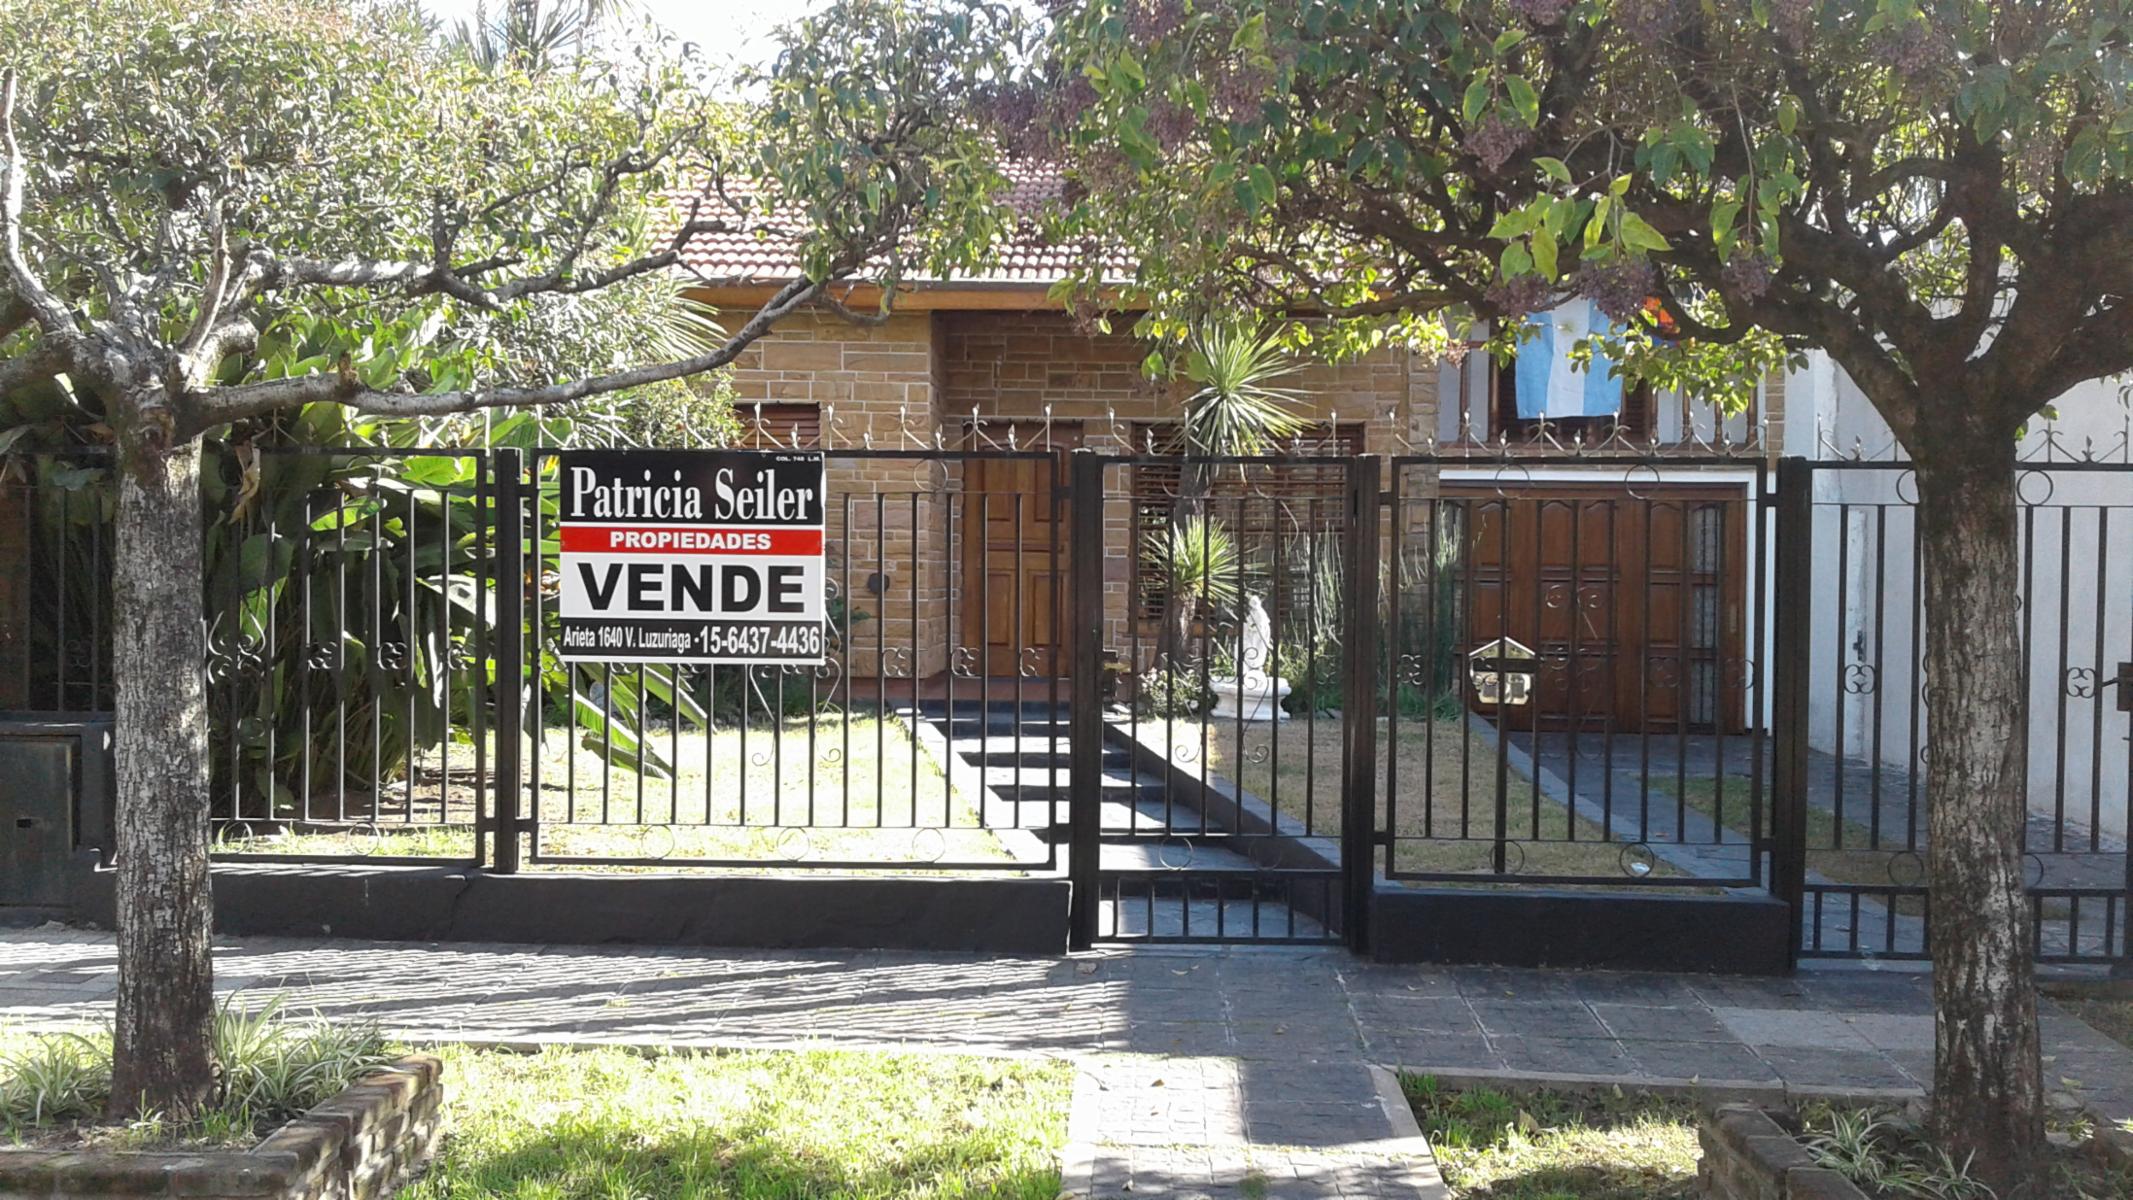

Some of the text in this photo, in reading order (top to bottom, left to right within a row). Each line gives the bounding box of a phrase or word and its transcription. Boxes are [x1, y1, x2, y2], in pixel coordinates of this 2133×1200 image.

[570, 466, 814, 520] Patricia Seiler
[610, 530, 772, 550] PROPIEDADES
[577, 562, 805, 613] VENDE
[563, 625, 820, 655] Arieta 1640 V. Luzuriaga 15-6437-4436
